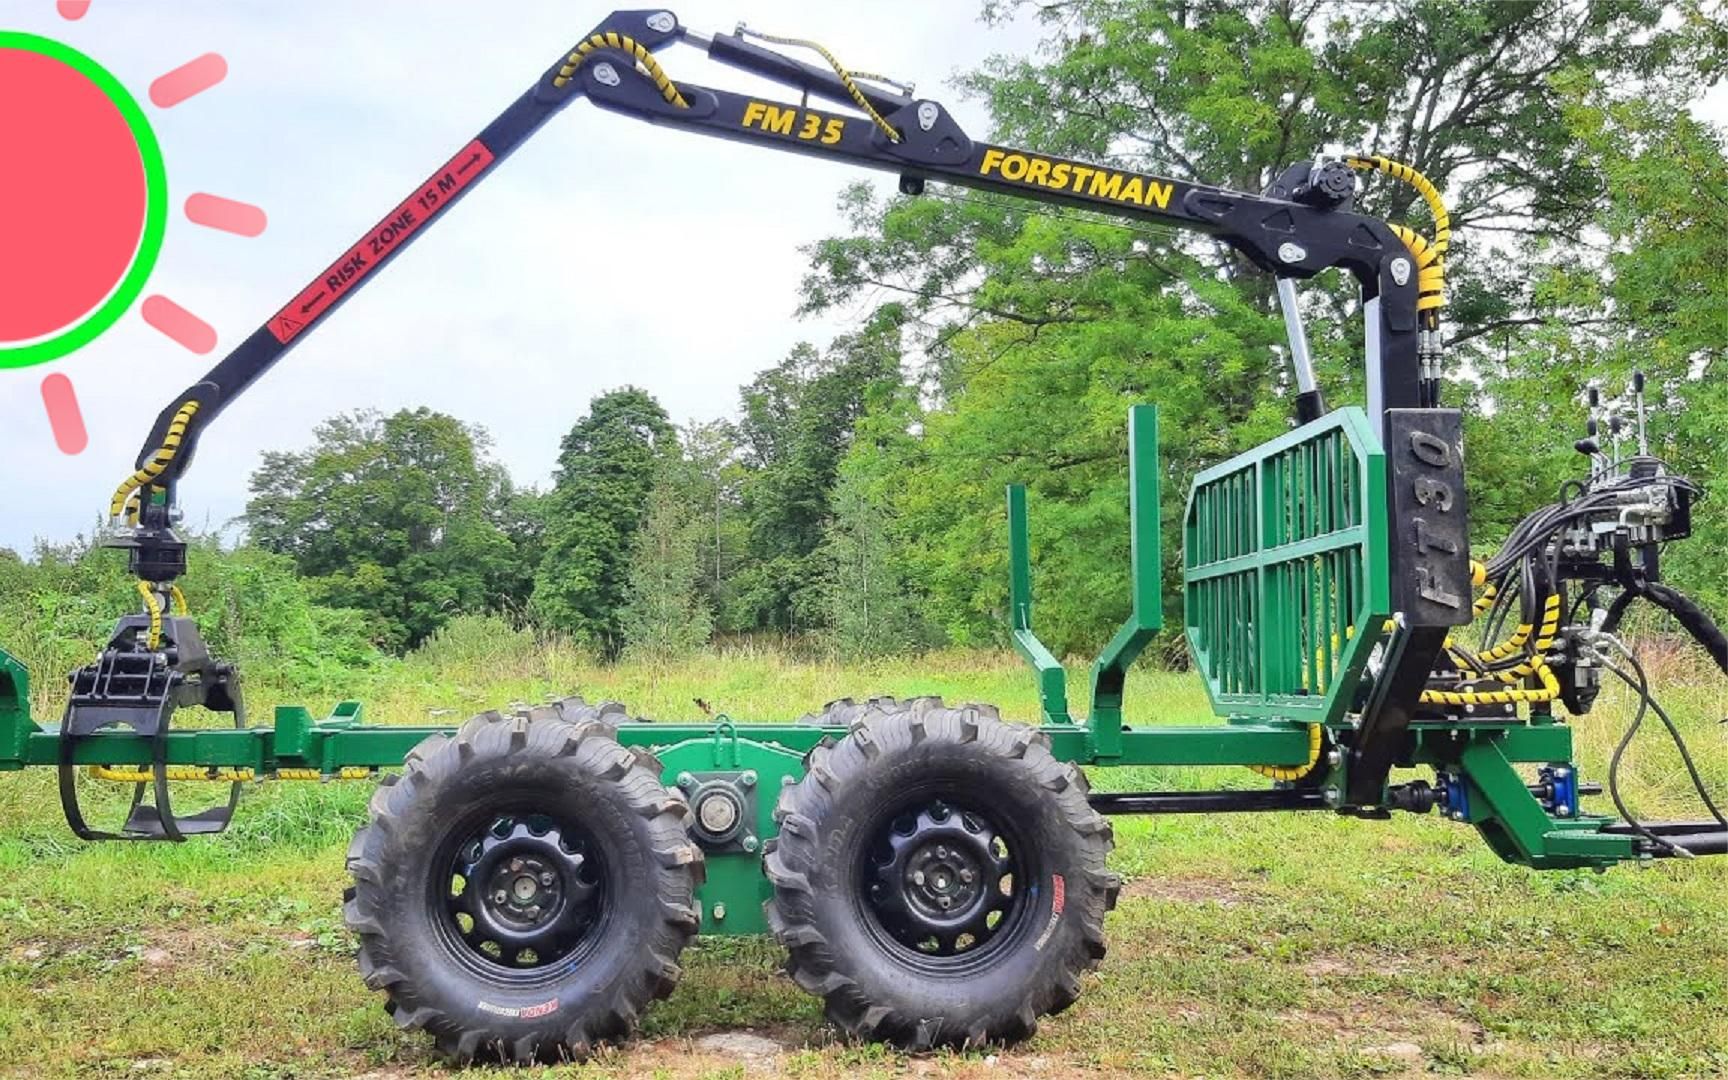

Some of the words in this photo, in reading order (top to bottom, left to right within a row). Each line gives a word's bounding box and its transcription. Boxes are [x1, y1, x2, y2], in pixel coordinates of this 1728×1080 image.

[742, 102, 796, 135] FM
[798, 113, 844, 144] 35
[980, 150, 1174, 209] FORSTMAN
[326, 252, 368, 293] RISK
[368, 209, 416, 255] ZONE
[417, 188, 438, 211] 15
[437, 173, 457, 195] M
[1410, 431, 1460, 609] FT30
